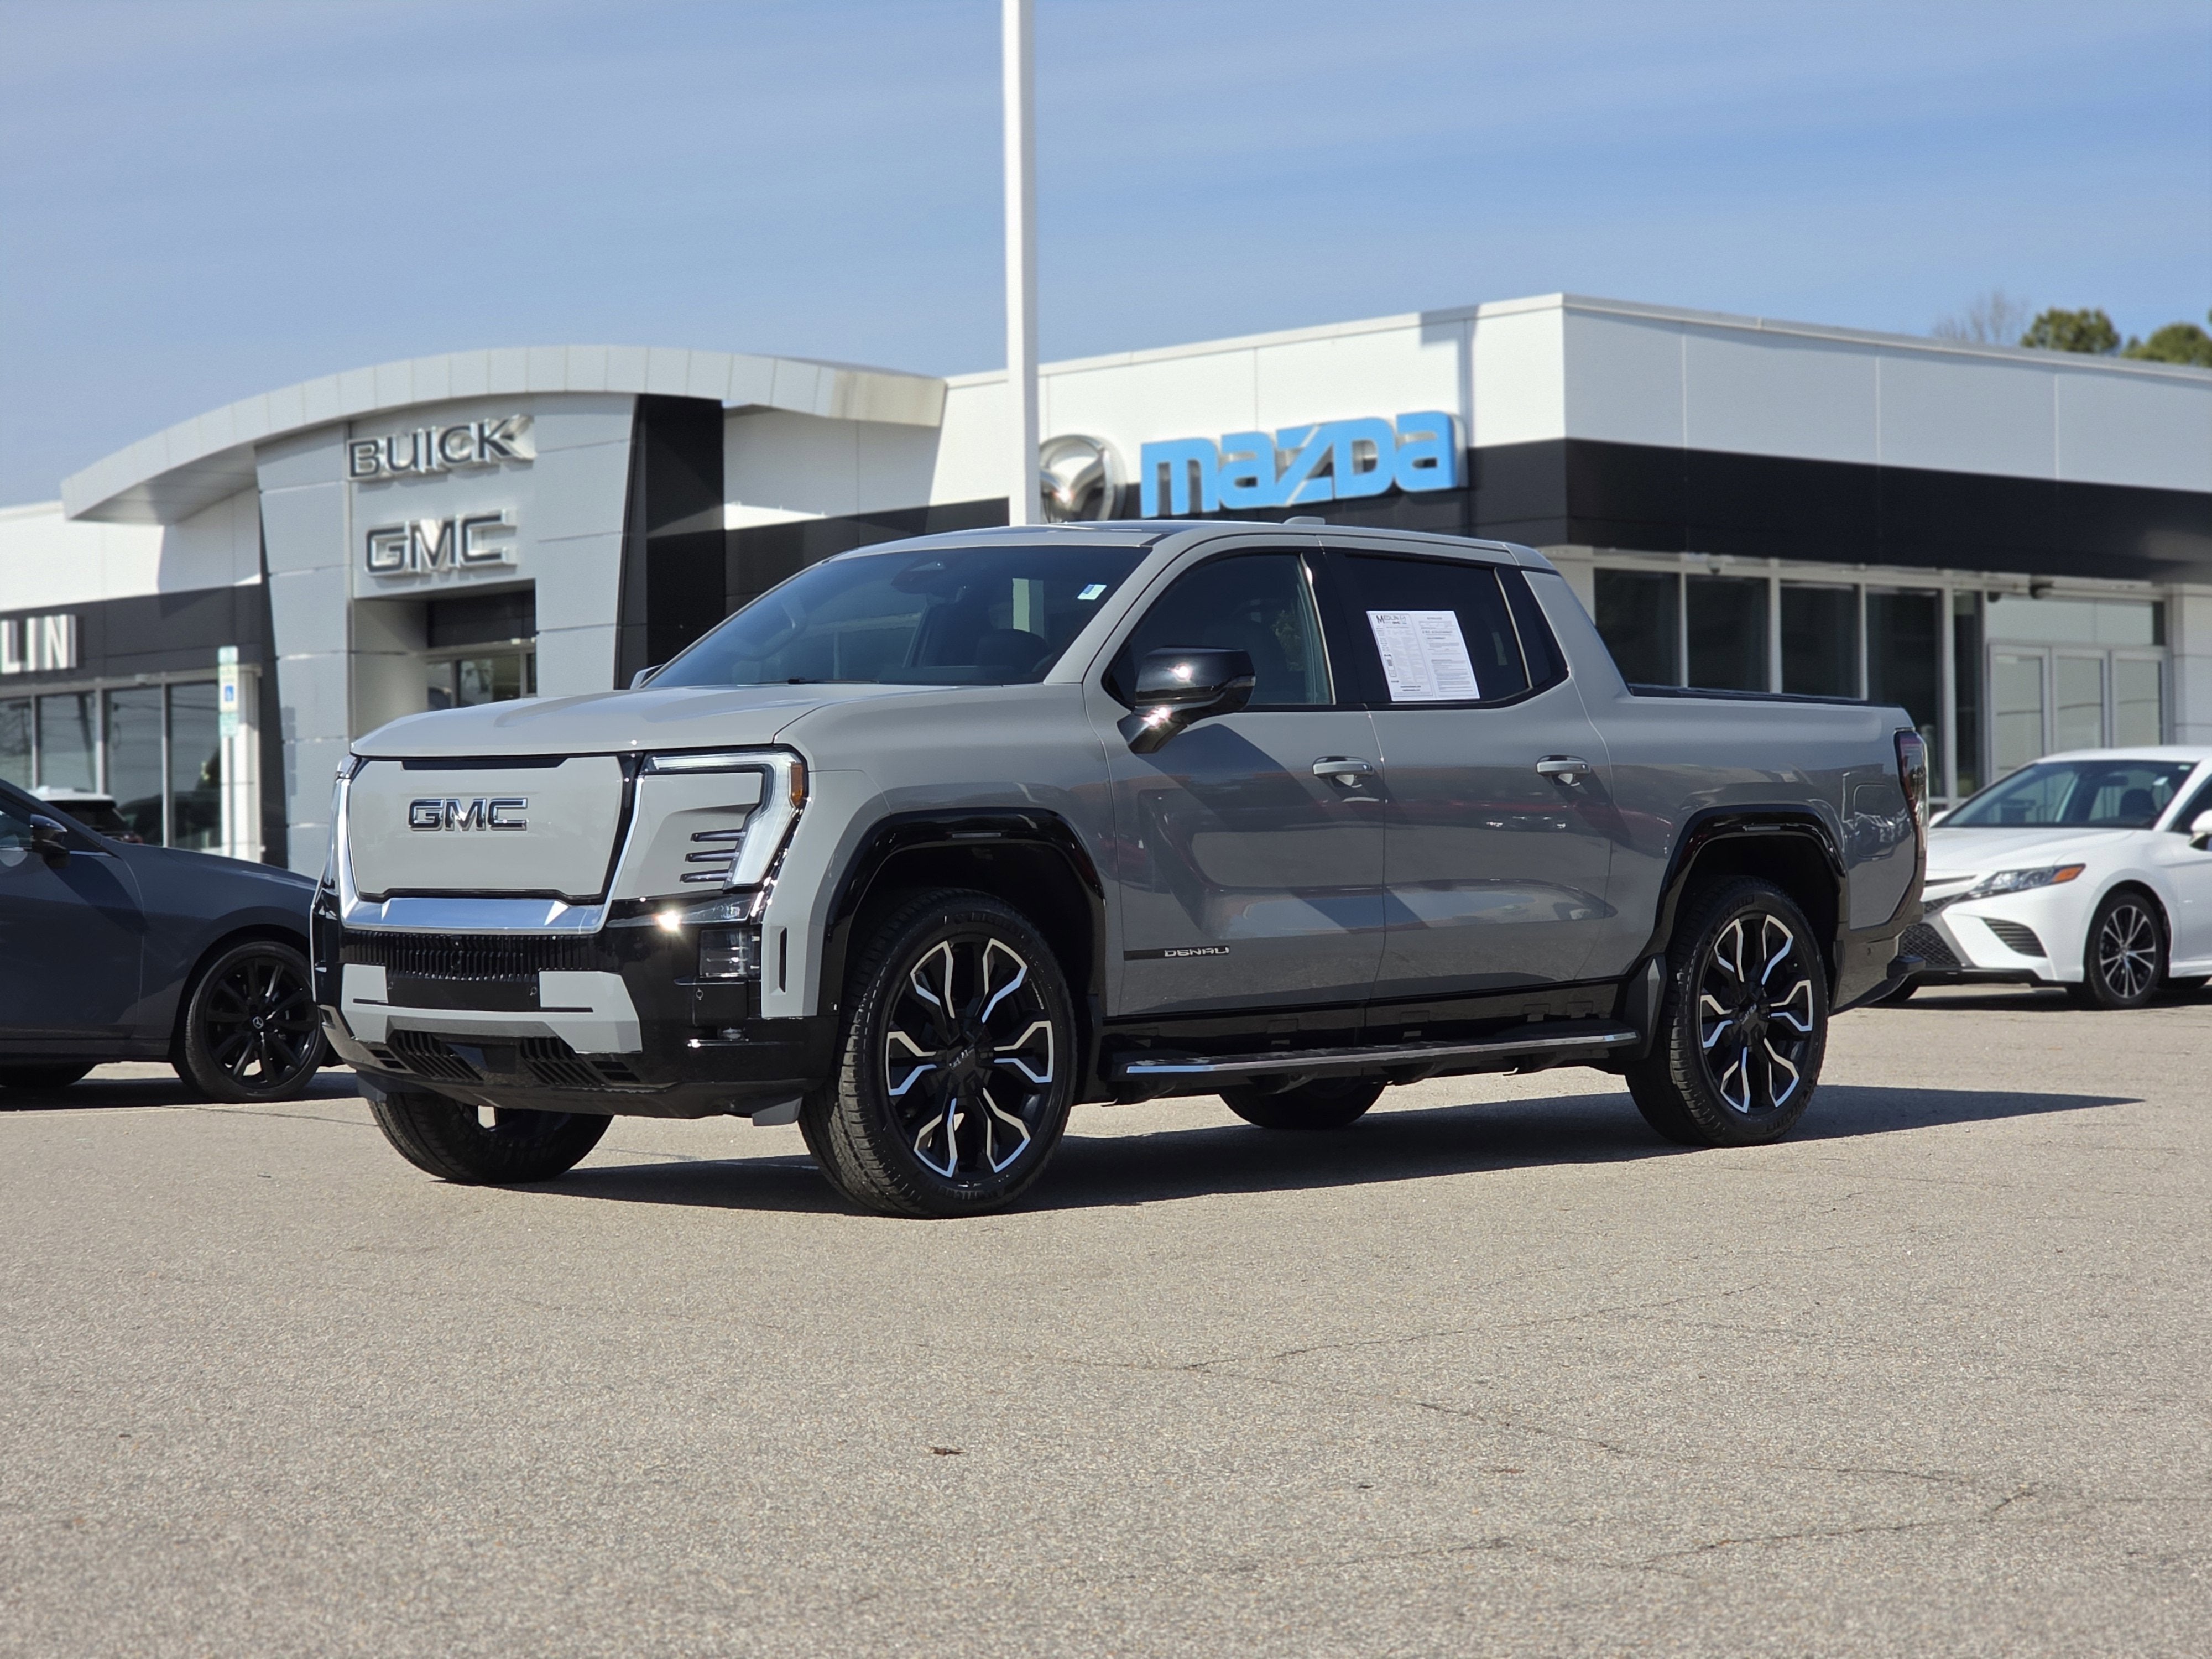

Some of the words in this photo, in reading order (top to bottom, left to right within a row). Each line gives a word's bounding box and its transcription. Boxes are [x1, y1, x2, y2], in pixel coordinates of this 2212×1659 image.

[348, 415, 524, 480] BUICK
[365, 510, 514, 575] GMC
[0, 614, 75, 674] LIN
[408, 797, 529, 832] GMC
[1164, 947, 1229, 957] DENALI
